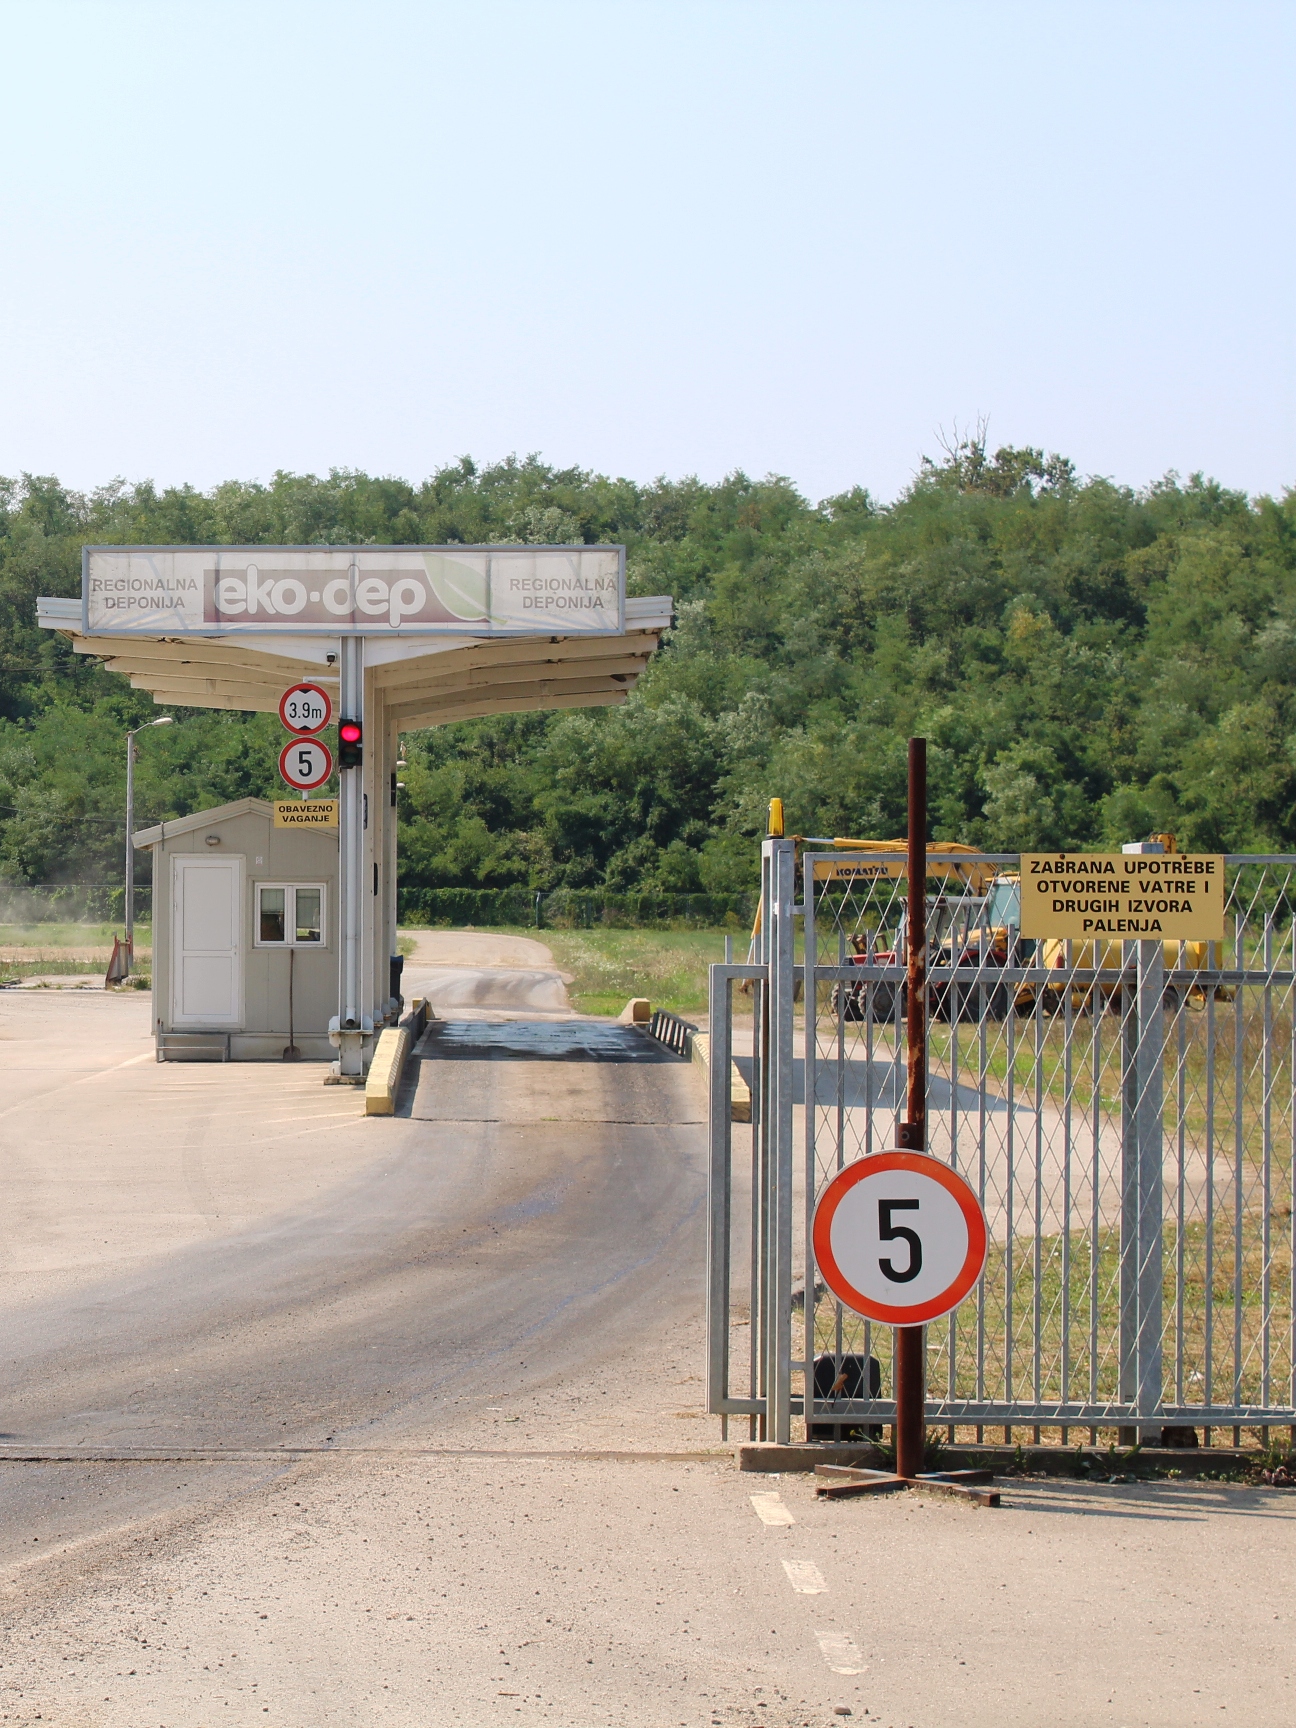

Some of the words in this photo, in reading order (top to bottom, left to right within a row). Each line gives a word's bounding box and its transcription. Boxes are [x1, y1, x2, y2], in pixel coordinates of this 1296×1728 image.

[92, 578, 198, 591] REGIONALNA
[510, 578, 617, 591] REGIONALNA
[105, 596, 185, 609] DEPONIJA
[523, 596, 604, 609] DEPONIJA
[289, 702, 322, 719] 3.9m
[298, 750, 312, 777] 5
[278, 805, 333, 813] OBAVEZNO
[282, 814, 330, 823] VAGANJE
[836, 866, 888, 877] KOMATSU
[1030, 861, 1115, 874] ZABRANA
[1124, 861, 1215, 874] UPOTREBE
[1037, 880, 1130, 893] OTVORENE
[1139, 880, 1196, 893] VATRE
[1204, 880, 1209, 893] I
[1052, 900, 1119, 913] DRUGIH
[1128, 900, 1193, 913] IZVORA
[1083, 919, 1163, 932] PALENJA
[878, 1199, 922, 1283] 5
